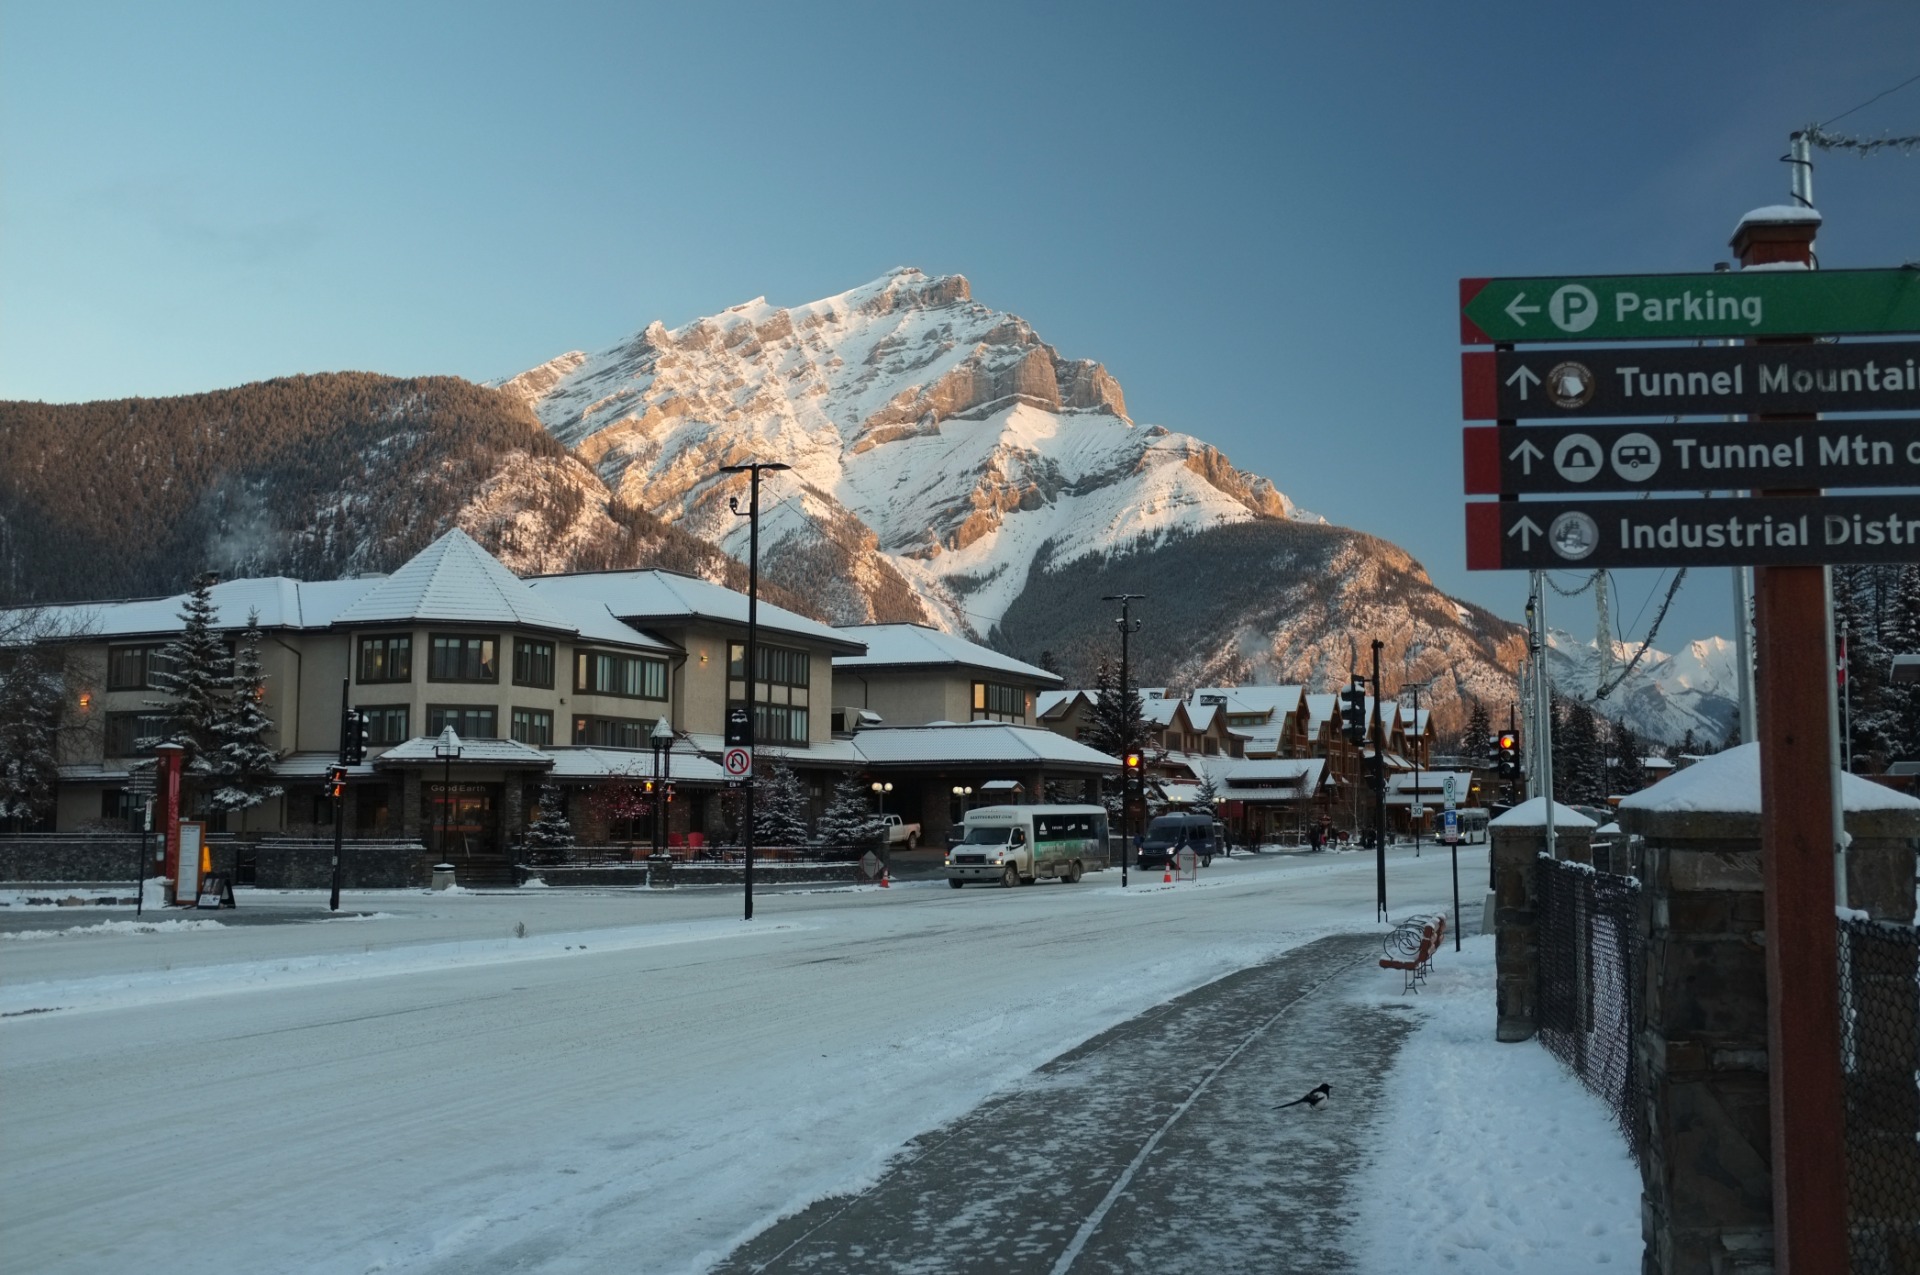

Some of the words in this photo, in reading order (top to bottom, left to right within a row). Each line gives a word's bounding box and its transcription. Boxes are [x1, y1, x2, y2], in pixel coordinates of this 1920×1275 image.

[1616, 290, 1762, 327] Parking
[1615, 363, 1743, 397] Tunnel
[1758, 358, 1920, 394] Mountai
[1672, 436, 1804, 470] Tunnel
[1818, 434, 1894, 466] Mtn
[1620, 515, 1808, 549] Industrial
[459, 785, 486, 793] Earth
[1413, 807, 1422, 815] 30
